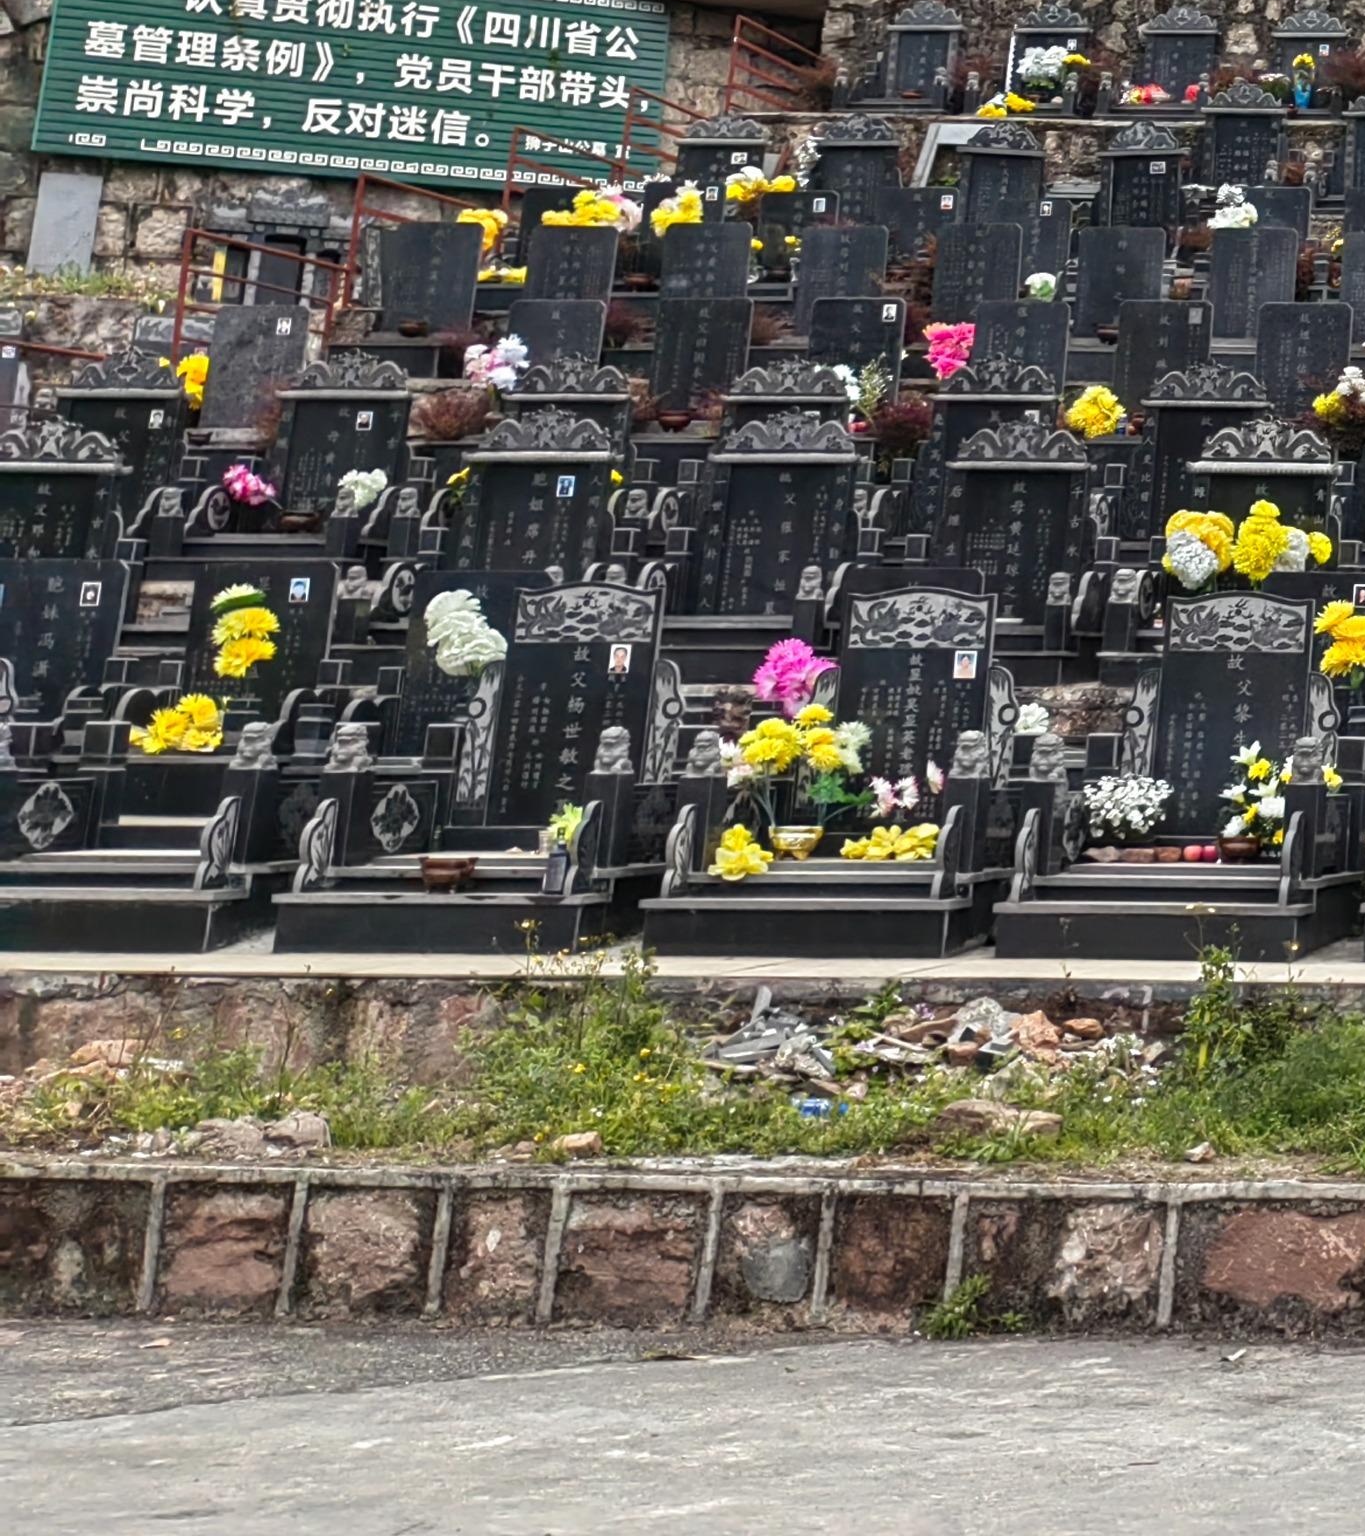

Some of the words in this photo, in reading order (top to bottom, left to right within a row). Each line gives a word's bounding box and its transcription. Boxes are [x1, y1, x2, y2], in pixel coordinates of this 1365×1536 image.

[84, 20, 651, 112] 墓管理条例》，党员干部带头，
[75, 74, 490, 148] 崇尚科学，反对迷信。
